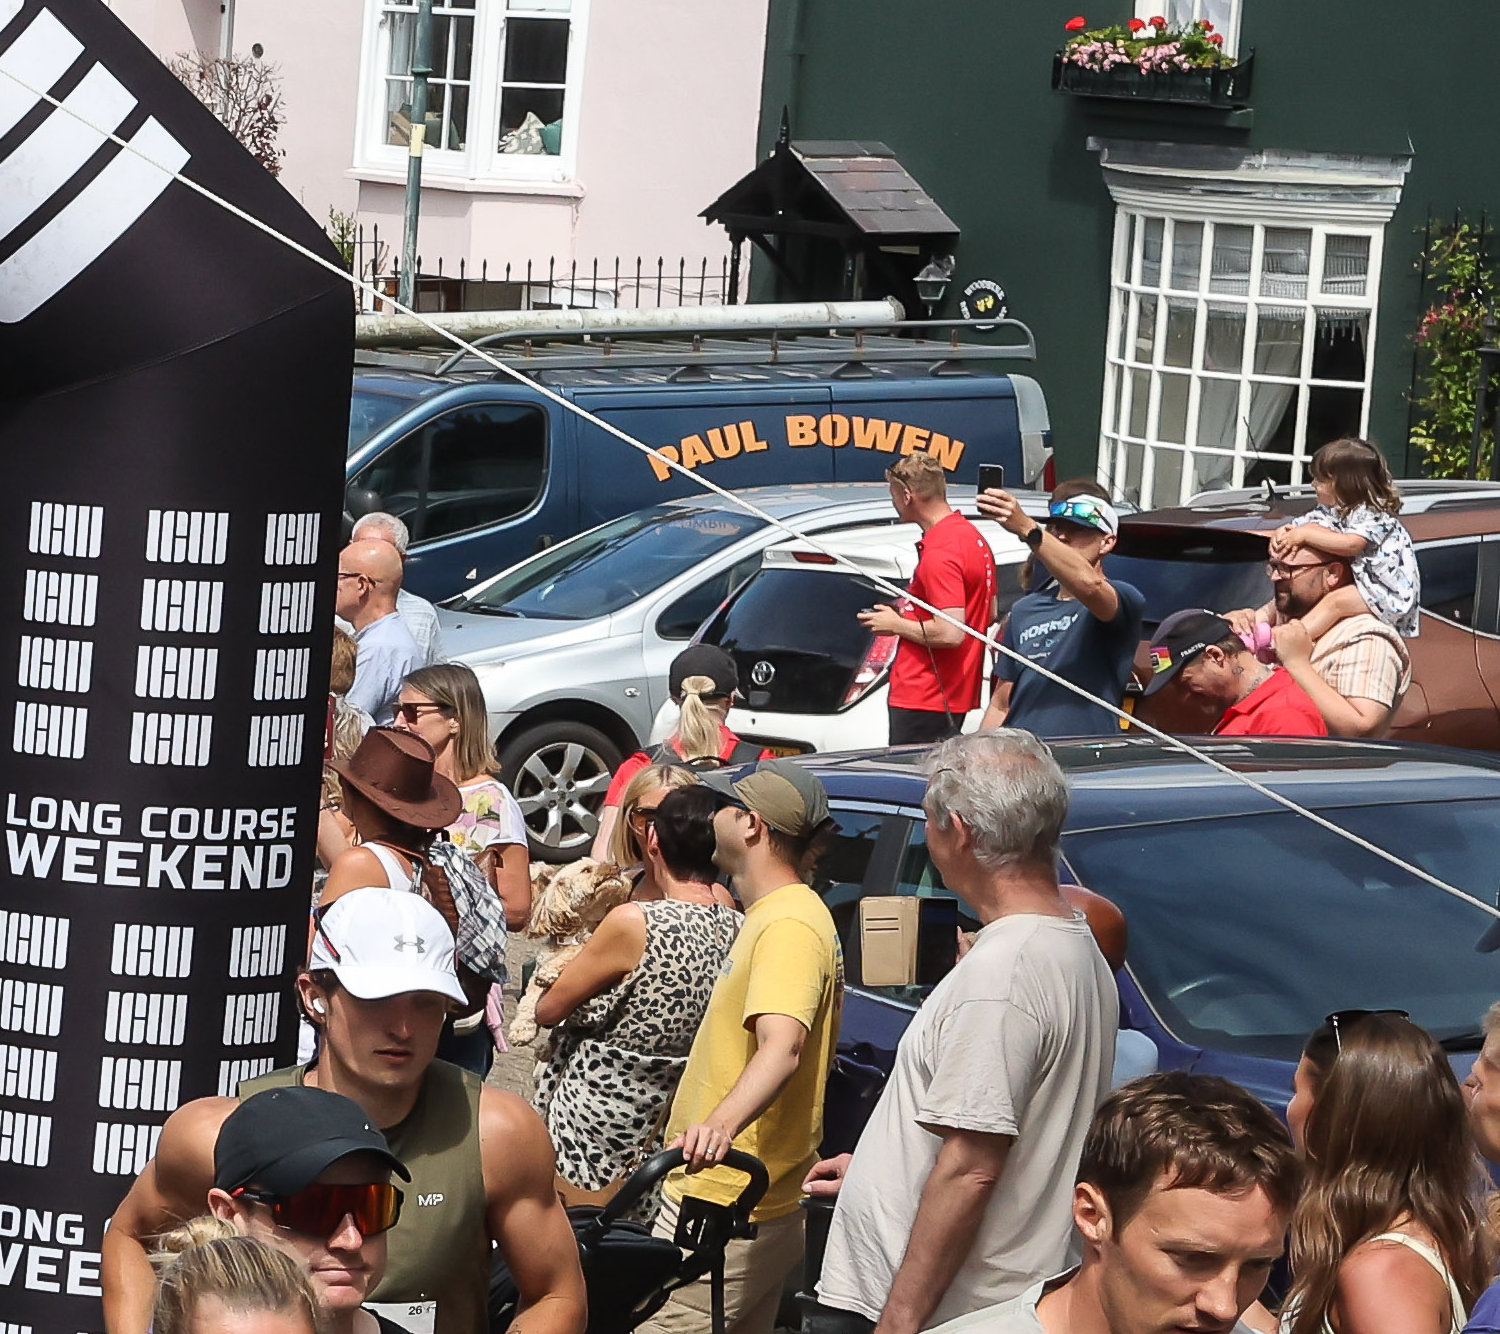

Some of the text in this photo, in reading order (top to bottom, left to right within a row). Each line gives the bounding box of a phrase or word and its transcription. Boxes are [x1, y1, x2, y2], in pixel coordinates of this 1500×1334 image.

[647, 414, 966, 482] PAUL BOWEN
[7, 793, 297, 841] LONG COURSE
[6, 829, 293, 890] WEEKEND
[418, 1193, 444, 1207] MP
[408, 1305, 423, 1316] 26
